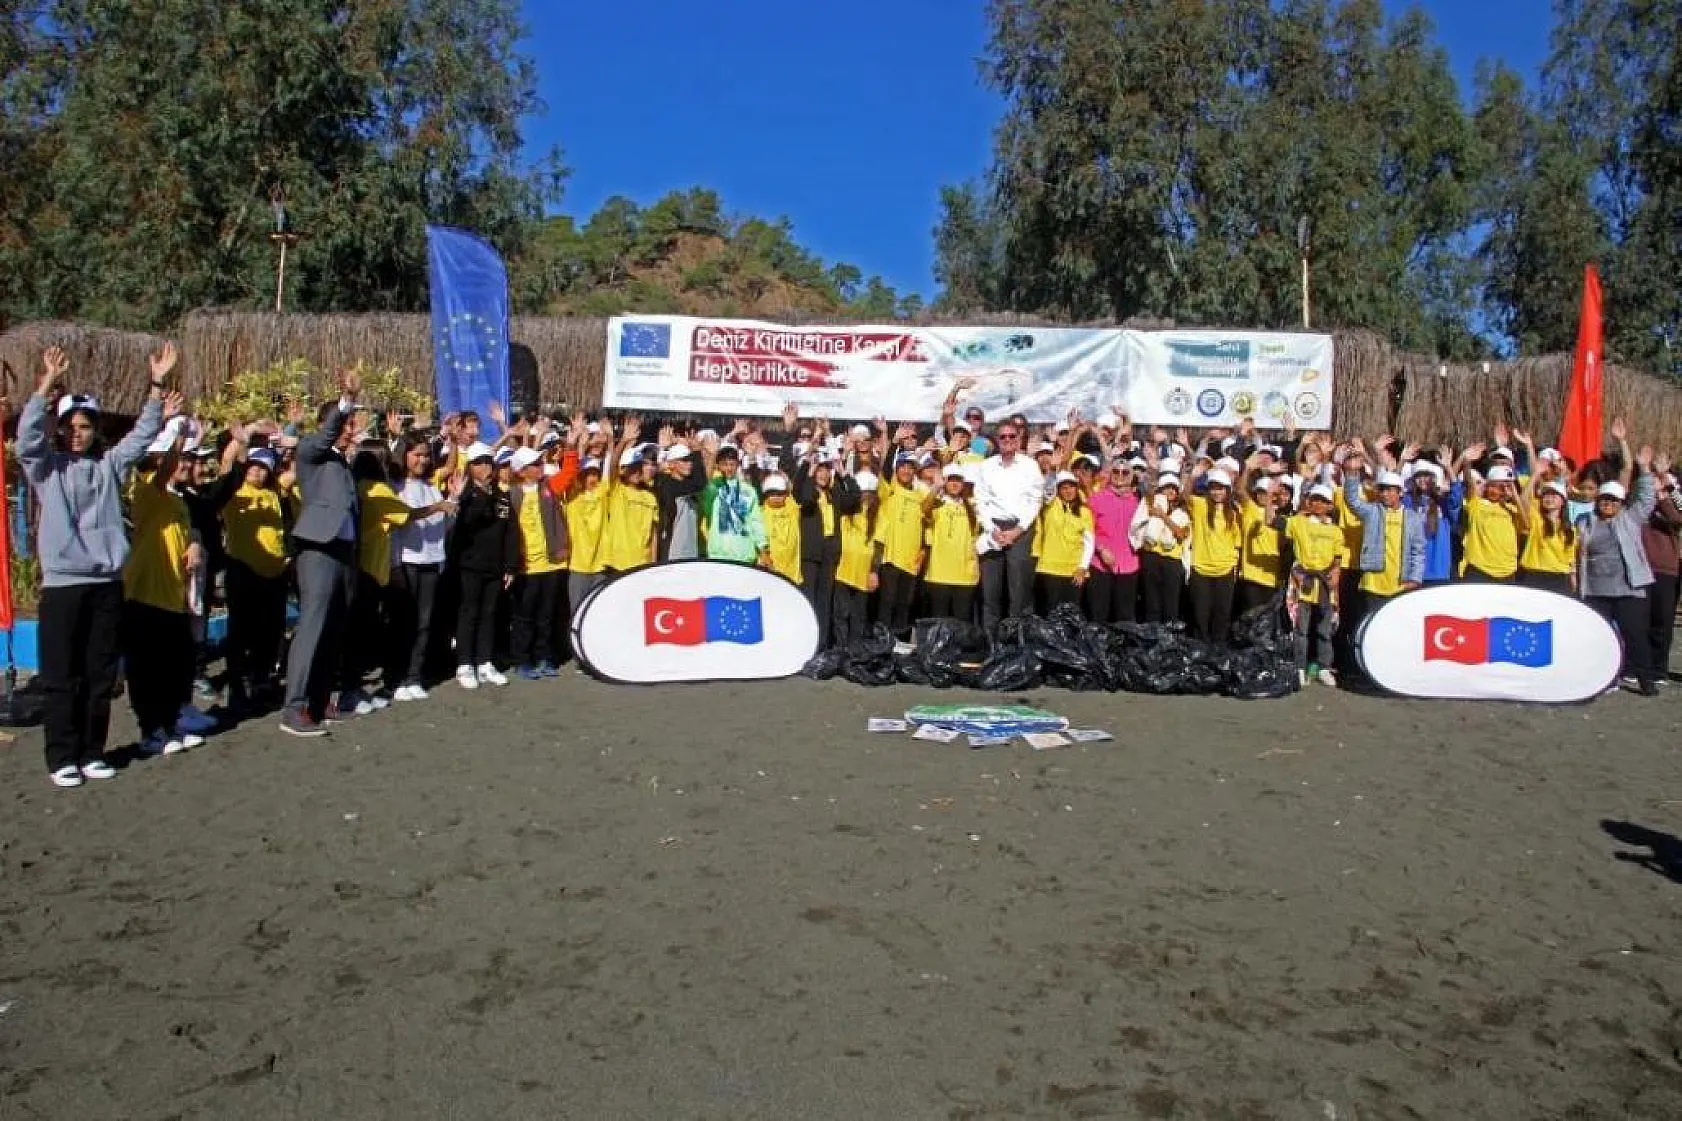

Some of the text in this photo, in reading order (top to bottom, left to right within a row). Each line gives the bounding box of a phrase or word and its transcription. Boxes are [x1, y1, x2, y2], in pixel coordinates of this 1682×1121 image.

[696, 328, 749, 351] Deniz
[694, 357, 734, 385] Hep
[738, 360, 809, 382] Birlikte
